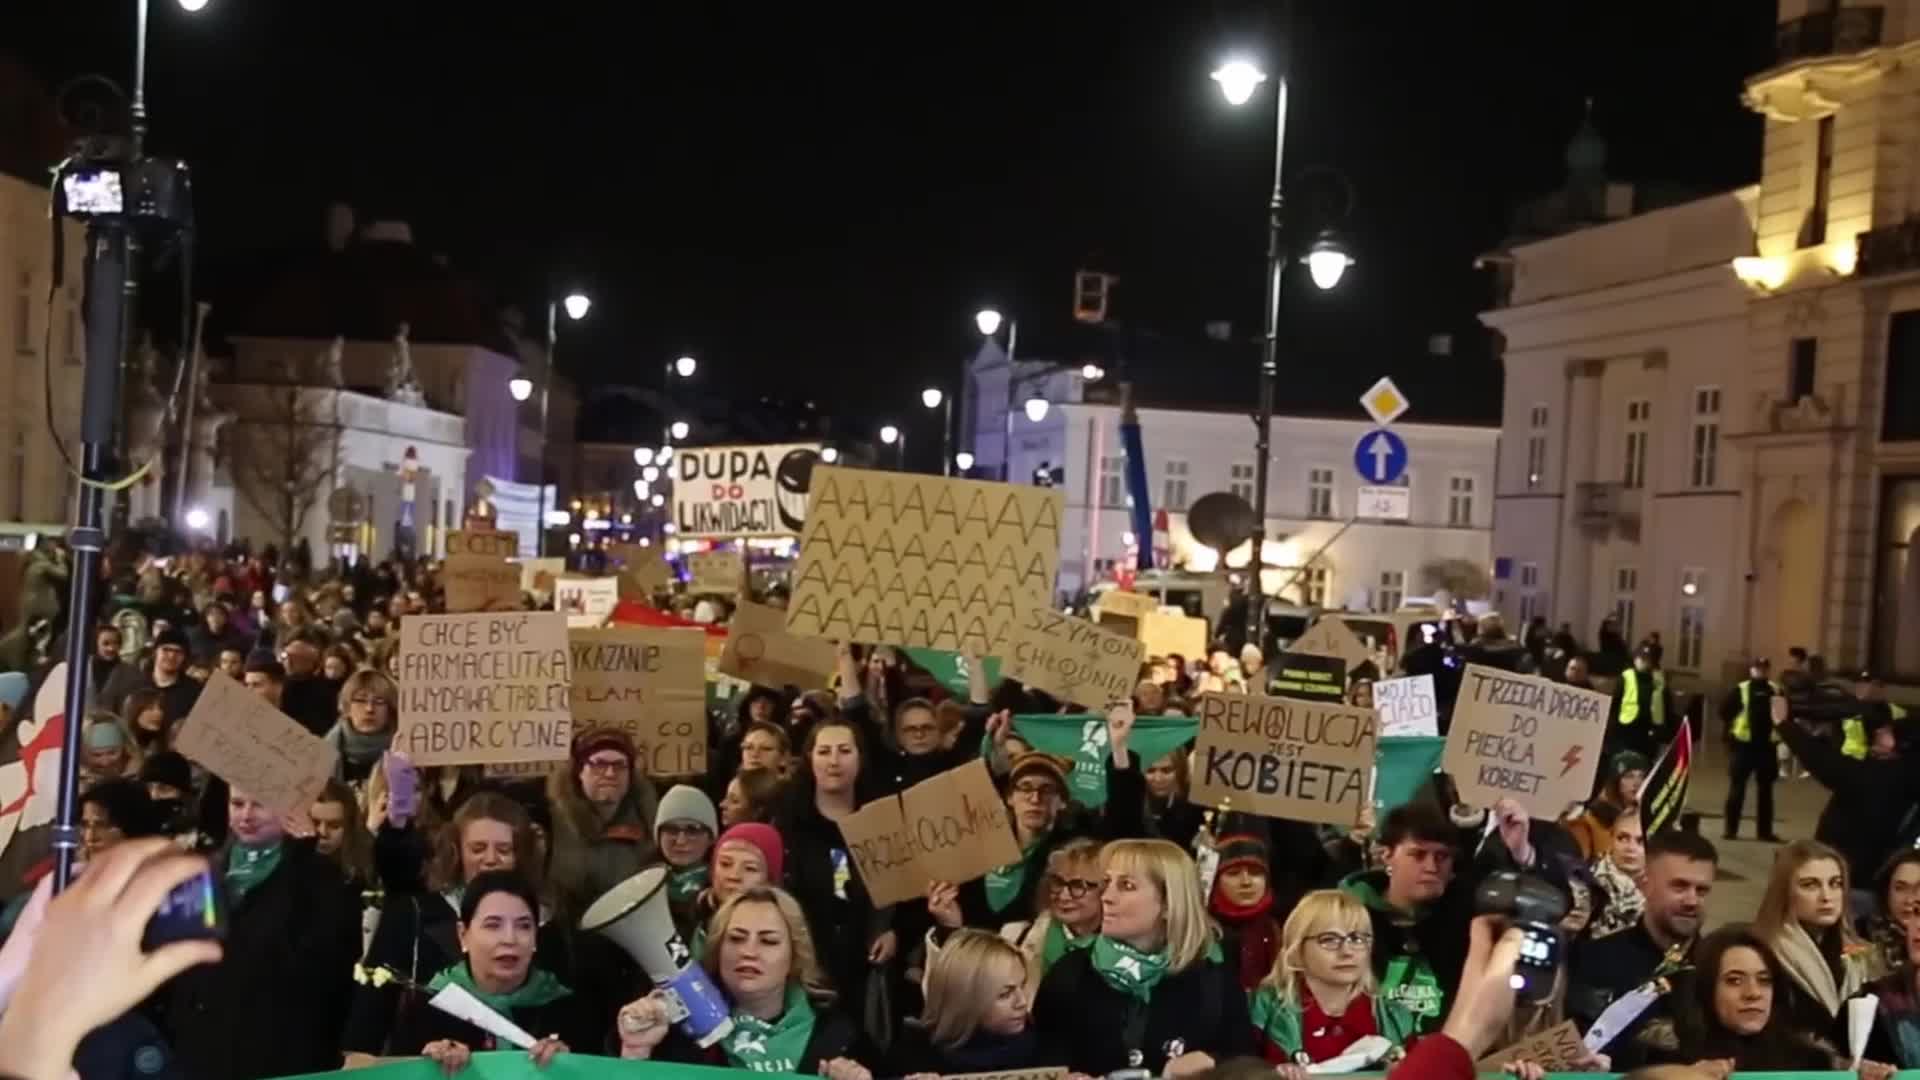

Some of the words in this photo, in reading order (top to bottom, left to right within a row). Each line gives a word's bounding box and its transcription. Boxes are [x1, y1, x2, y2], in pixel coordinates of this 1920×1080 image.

[680, 450, 772, 482] DUPA
[712, 484, 744, 499] DO
[679, 499, 775, 532] LIKWIDACJI
[1024, 608, 1142, 662] SZYMON
[1471, 673, 1545, 711] TRZECIA
[1548, 688, 1601, 723] DROGA
[409, 720, 570, 752] ABORCYJNE
[1202, 695, 1374, 751] REWOLUCJA
[1509, 714, 1538, 737] DO
[1268, 742, 1304, 758] JEST
[1465, 730, 1536, 766] PIEKŁA
[1204, 746, 1364, 805] KOBIETA
[1477, 765, 1548, 795] KOBIET
